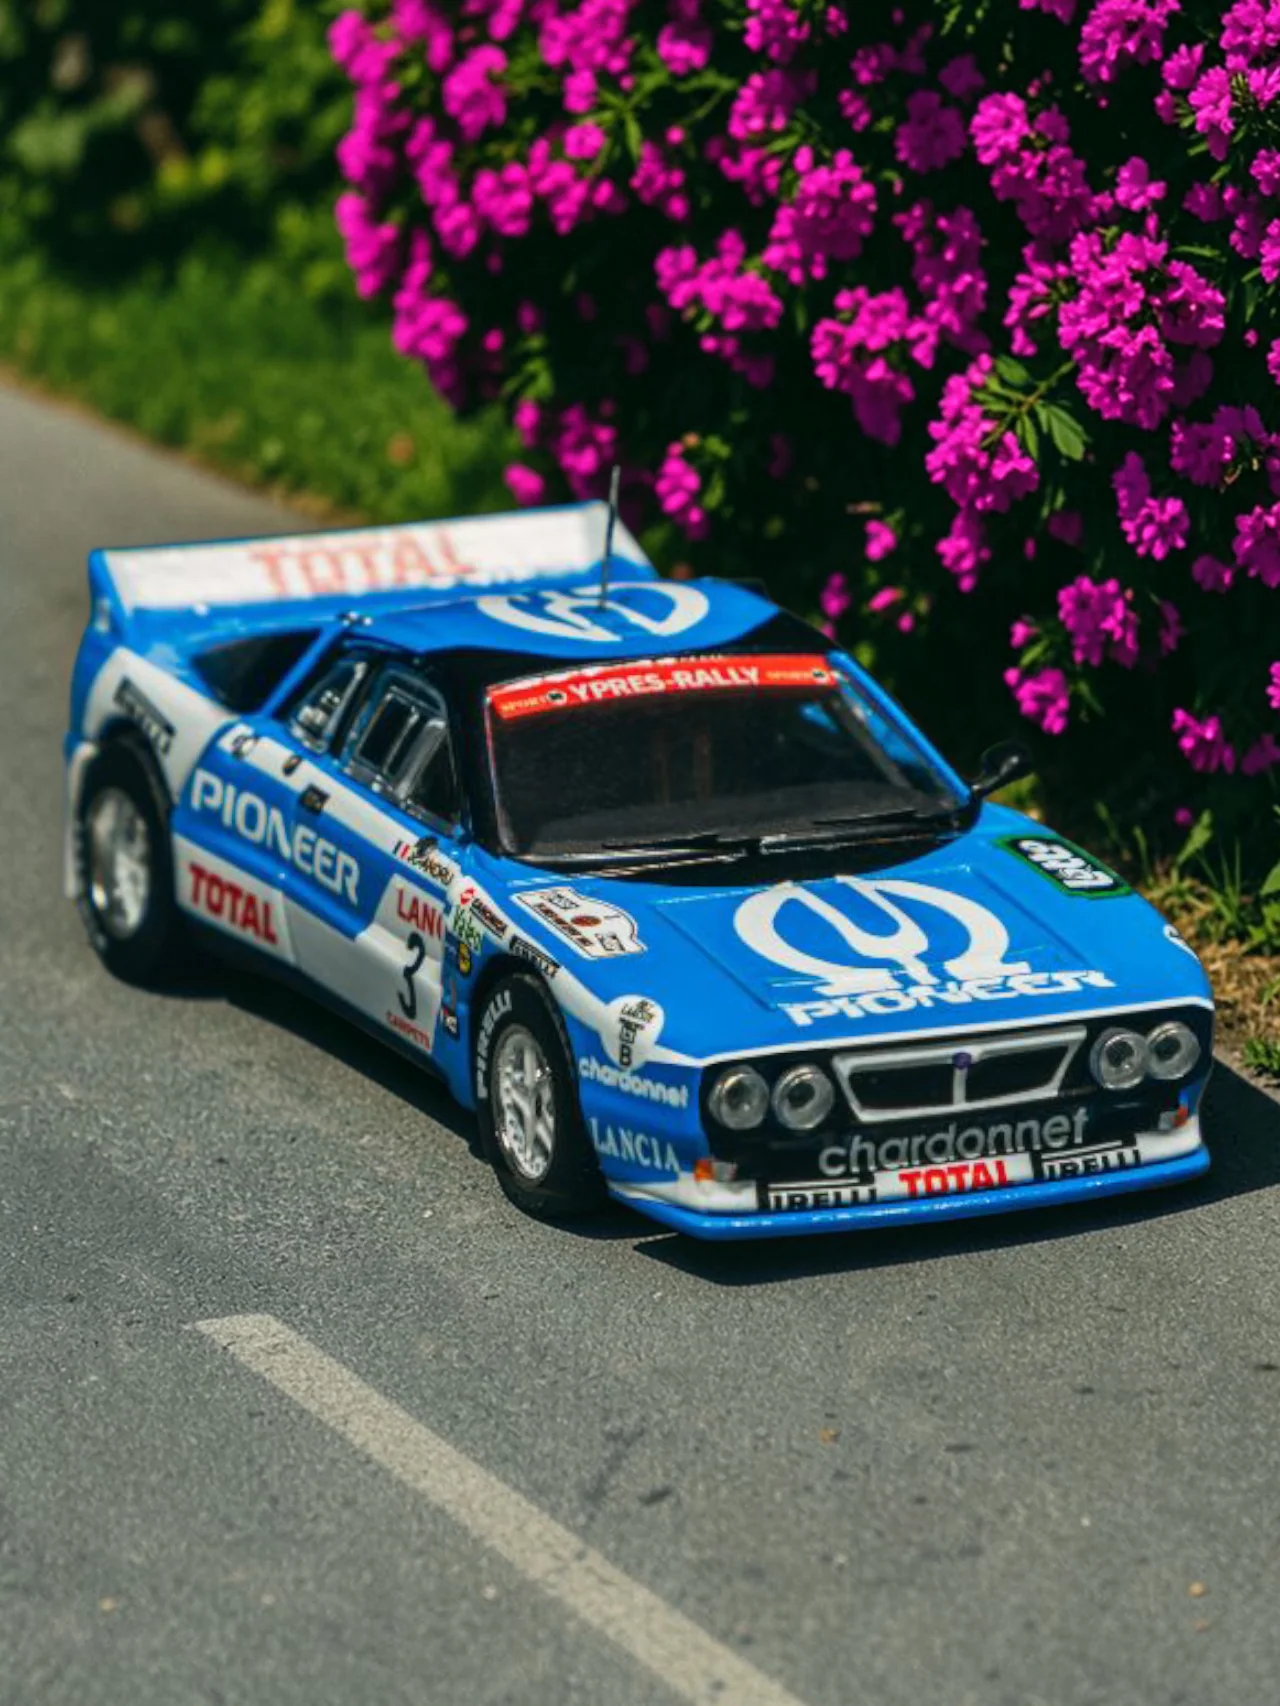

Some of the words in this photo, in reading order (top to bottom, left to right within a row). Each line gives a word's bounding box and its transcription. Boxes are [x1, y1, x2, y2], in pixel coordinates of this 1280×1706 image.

[249, 524, 475, 597] TOTAL
[569, 666, 759, 701] YPRES-RALLY
[191, 768, 360, 907] PIONEER
[189, 861, 279, 946] TOTAL
[397, 931, 425, 1019] 3
[777, 968, 1117, 1028] PIONEER
[578, 1055, 689, 1109] chardonnet
[589, 1115, 682, 1173] LANCIA
[818, 1106, 1089, 1177] chardonnet
[898, 1159, 1009, 1198] TOTAL
